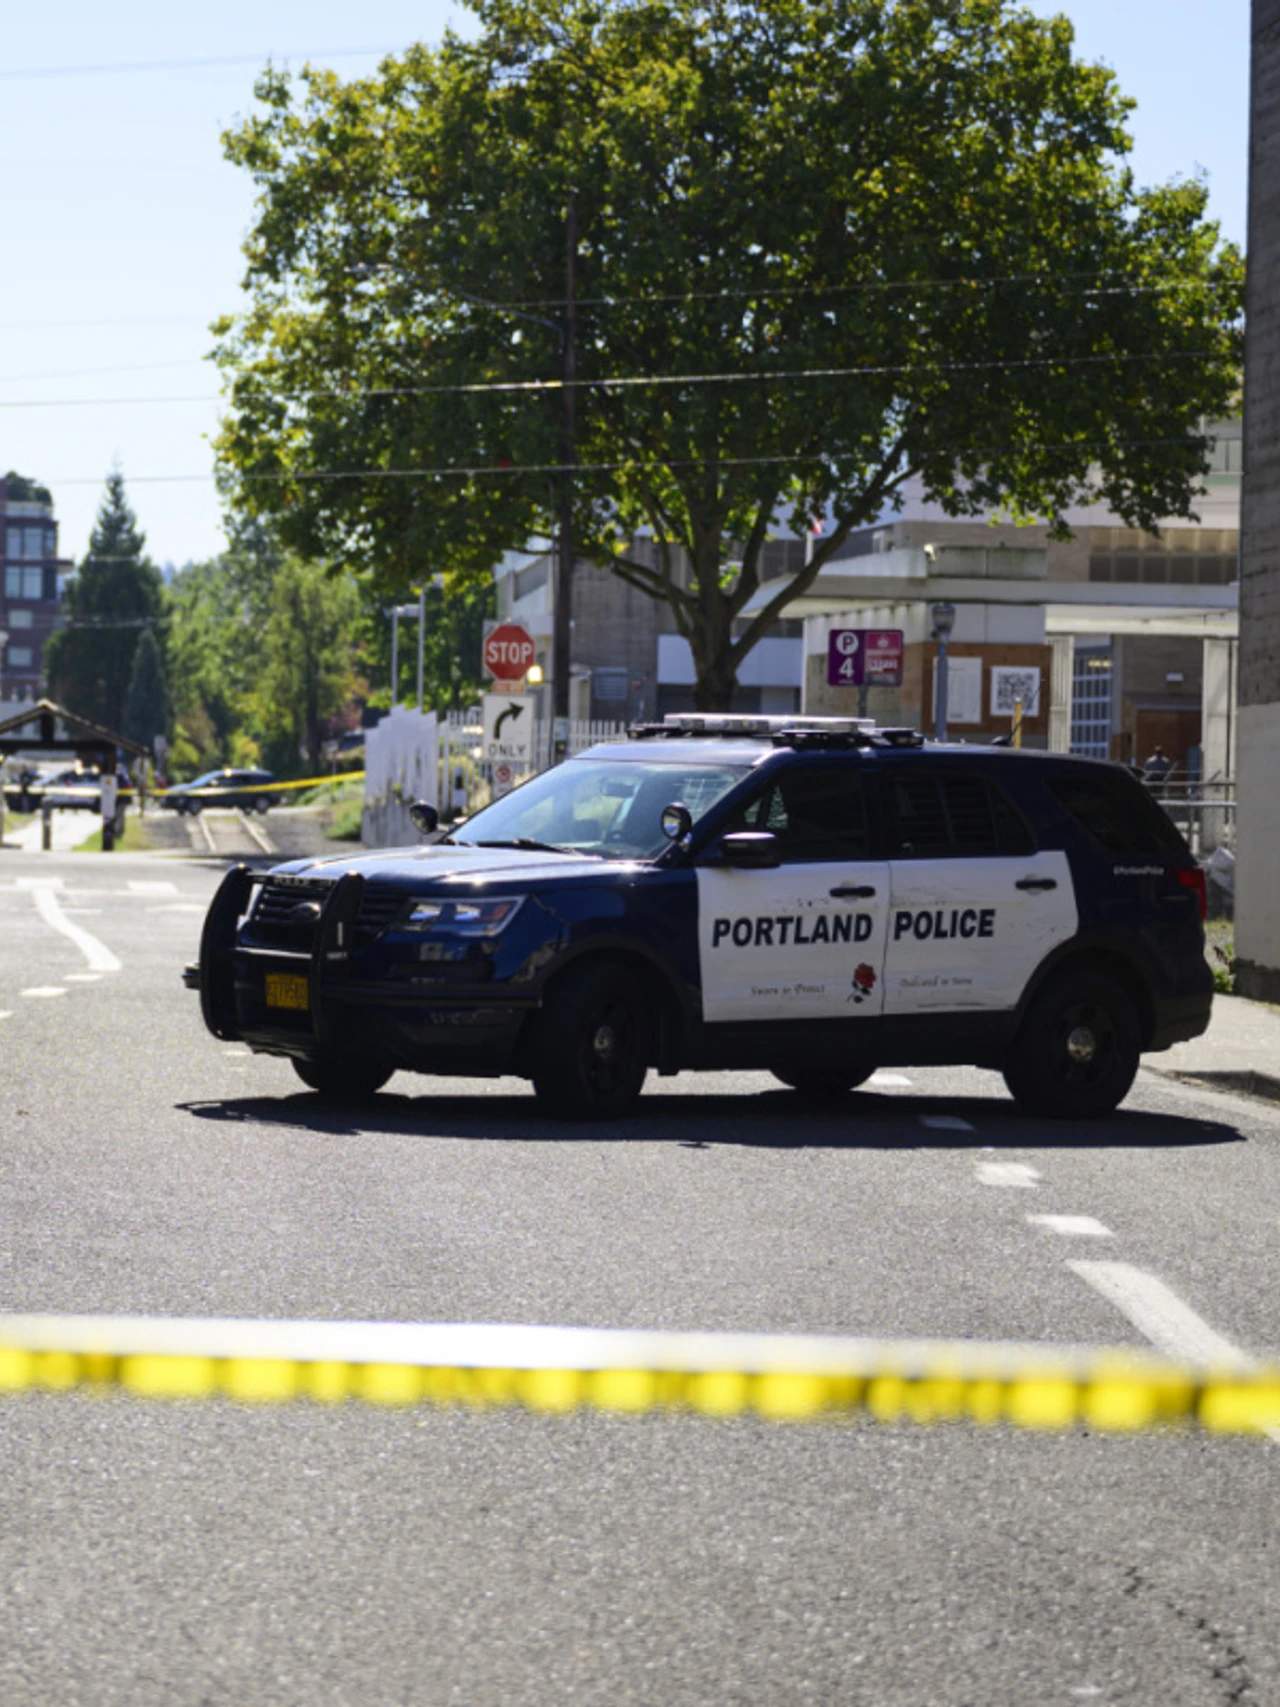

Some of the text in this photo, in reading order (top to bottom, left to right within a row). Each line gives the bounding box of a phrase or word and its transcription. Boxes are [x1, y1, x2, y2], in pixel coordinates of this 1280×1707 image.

[487, 641, 533, 665] STOP
[842, 635, 854, 651] P
[839, 657, 854, 678] 4
[487, 743, 526, 757] ONLY
[712, 908, 997, 948] PORTLAND POLICE
